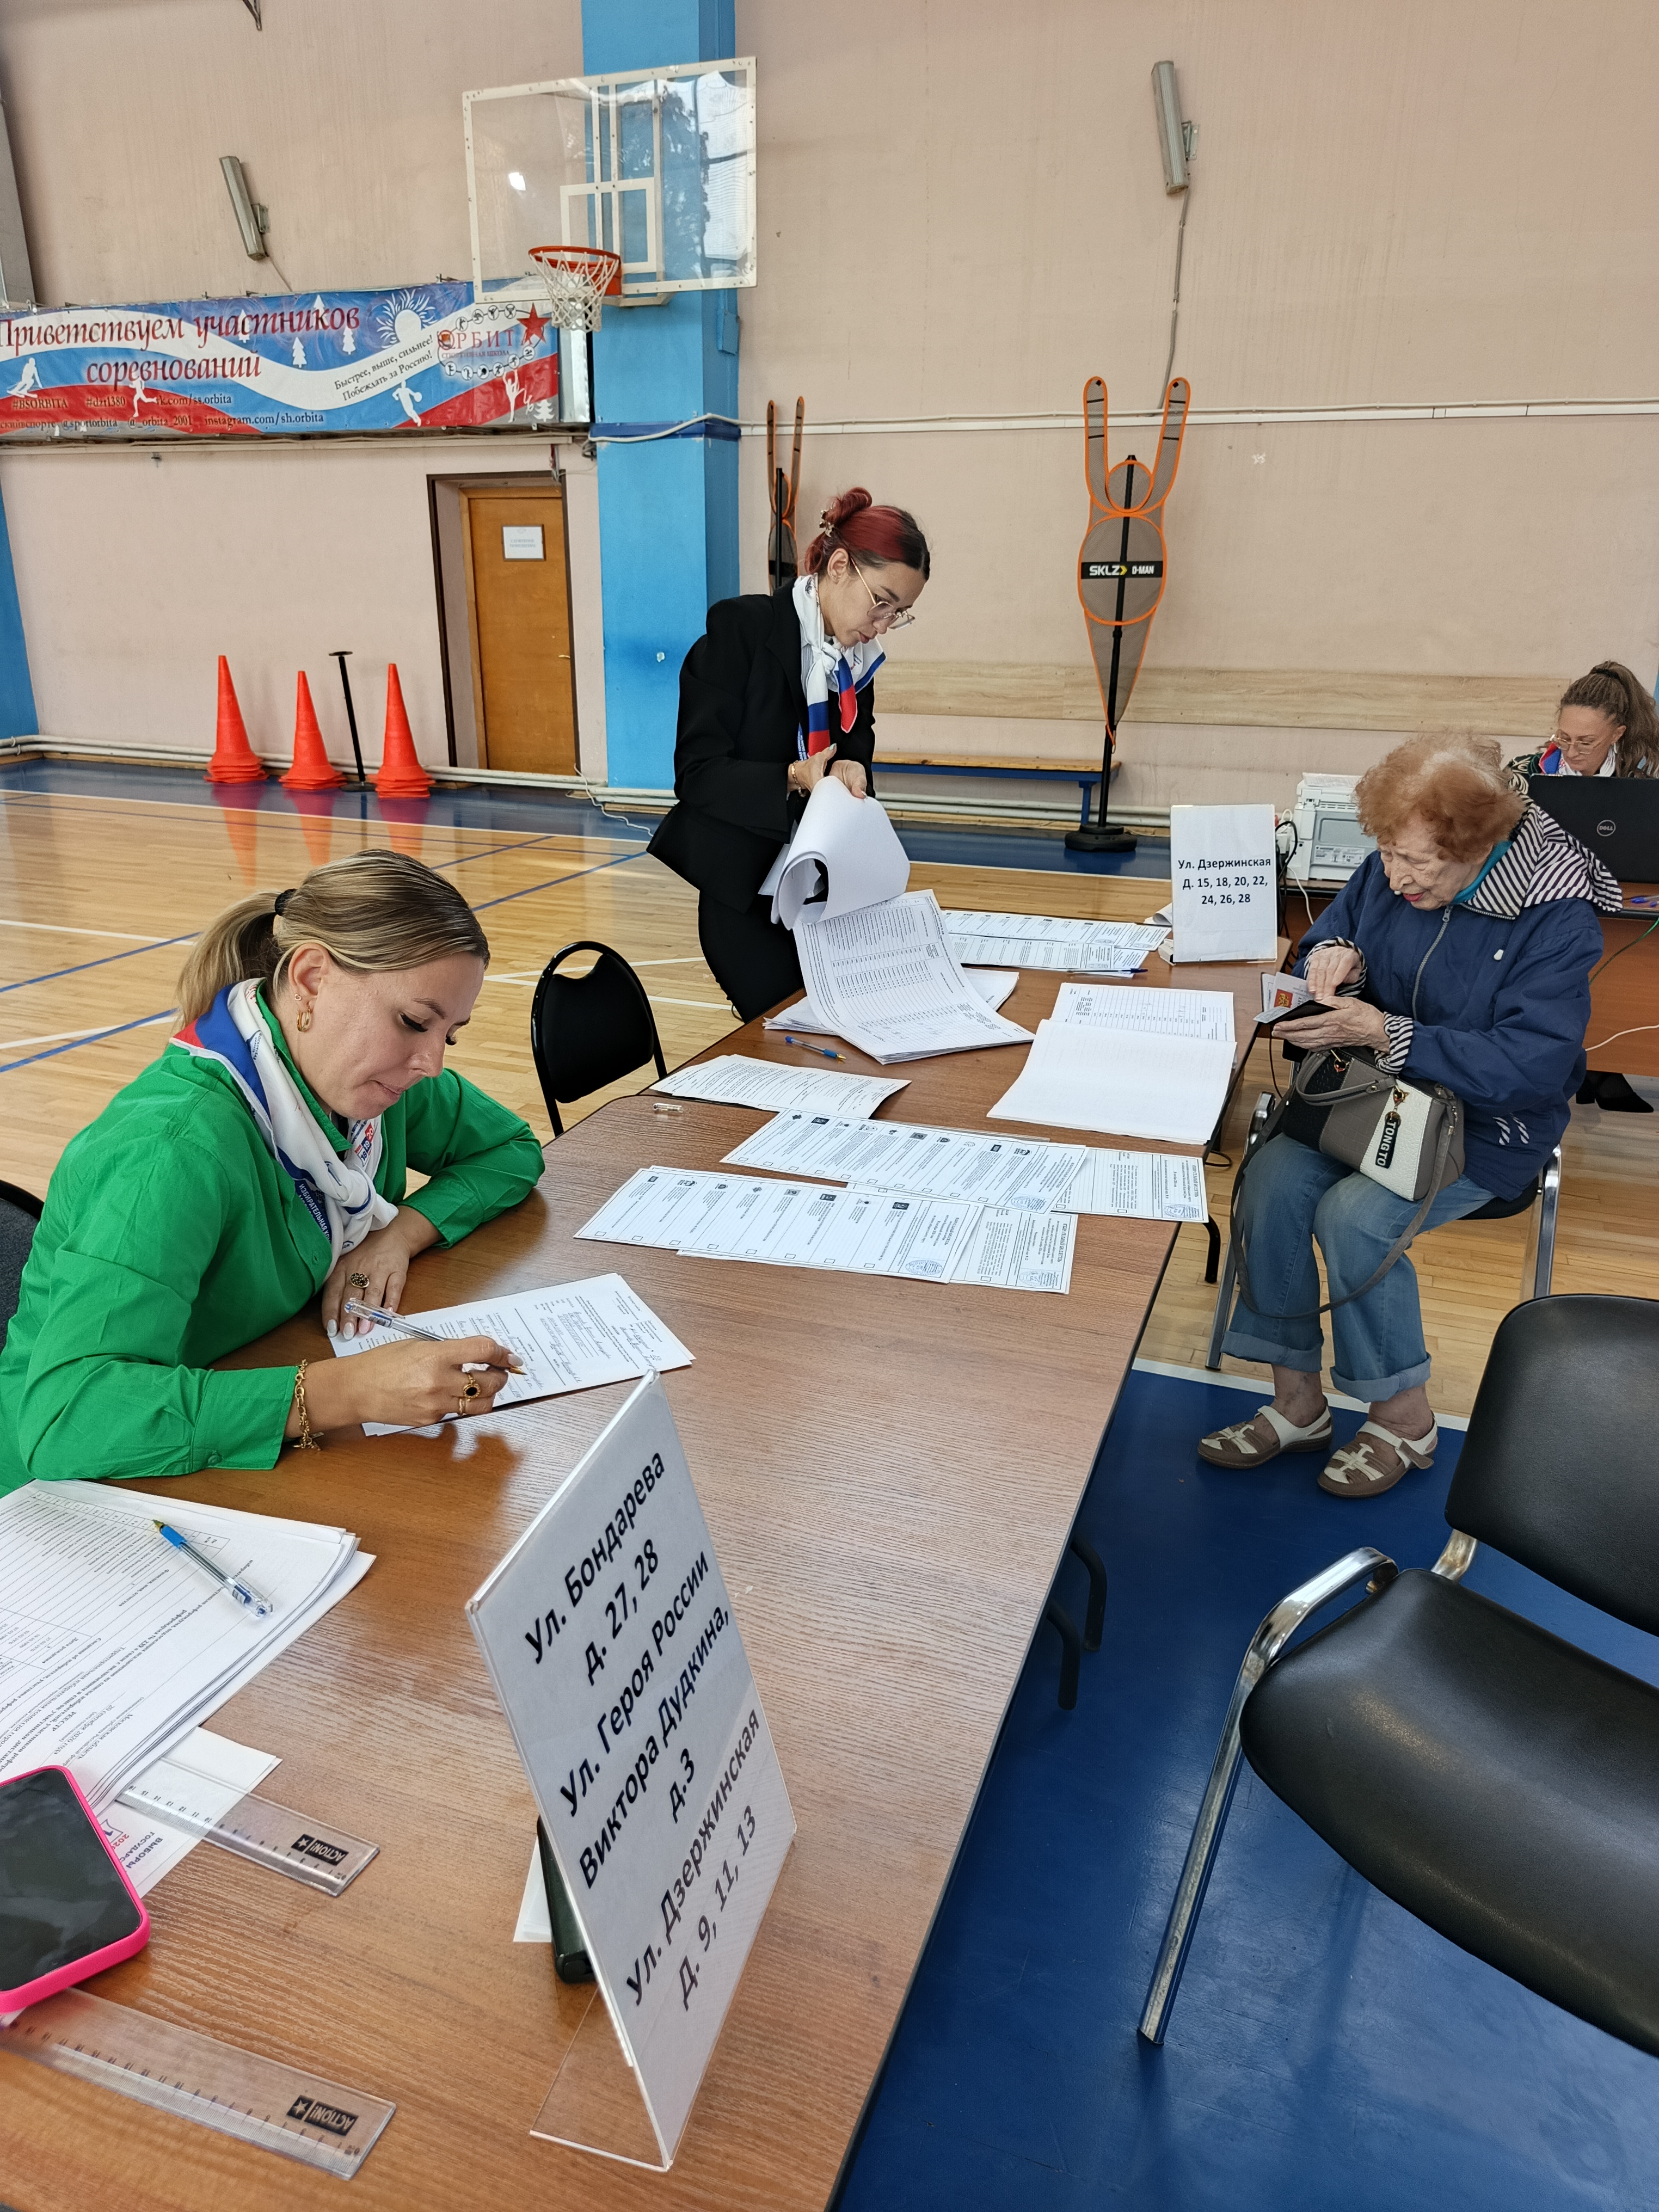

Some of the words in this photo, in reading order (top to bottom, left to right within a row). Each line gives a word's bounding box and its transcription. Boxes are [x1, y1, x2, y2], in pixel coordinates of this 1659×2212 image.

[0, 317, 185, 357] Приветствуем
[193, 306, 360, 348] участников
[87, 349, 262, 391] соревнований
[334, 369, 371, 390] Быстрее,
[372, 356, 397, 372] выше,
[398, 334, 433, 358] сильнее!
[342, 376, 388, 401] Побеждать
[389, 370, 398, 379] за
[398, 350, 432, 374] Россию!
[13, 398, 68, 409] #BSORBITA
[1089, 565, 1121, 576] SKLZ
[1178, 859, 1195, 869] Ул.
[1197, 858, 1271, 870] Дзержинская
[1182, 878, 1194, 890] Д.
[1197, 878, 1213, 889] 15,
[1216, 877, 1231, 888] 18,
[1234, 876, 1250, 887] 20,
[1252, 876, 1268, 887] 22,
[1201, 895, 1216, 906] 24,
[1220, 894, 1235, 905] 26,
[1238, 894, 1251, 903] 28
[364, 1140, 370, 1150] 19
[366, 1128, 374, 1140] 20
[1377, 1121, 1397, 1167] TONGTO
[299, 1183, 328, 1231] ИЗБИРАТЕЛЬНАЯ
[525, 1608, 567, 1664] Ул.
[564, 1453, 665, 1608] Бондарева
[605, 1582, 637, 1639] 27,
[635, 1539, 658, 1590] 28
[153, 1609, 188, 1635] референдума
[65, 1637, 80, 1646] Дата
[77, 1637, 102, 1655] Сведения
[42, 1658, 73, 1680] избирателе,
[79, 1645, 126, 1680] Территориальная
[15, 1678, 45, 1699] участнике
[80, 1664, 118, 1692] включением
[560, 1758, 600, 1817] Ул.
[597, 1650, 654, 1754] Героя
[652, 1551, 709, 1656] России
[40, 1679, 82, 1710] избирательная
[54, 1694, 78, 1711] список
[12, 1709, 44, 1732] комиссия
[48, 1695, 87, 1724] избирателей,
[50, 1711, 77, 1731] РЕЕСТР
[79, 1710, 107, 1730] сентября
[14, 1723, 53, 1752] участников
[18, 1710, 59, 1740] участников
[99, 1713, 134, 1740] Московская
[51, 1742, 69, 1755] года
[75, 1740, 101, 1760] область
[580, 1735, 659, 1889] Виктора
[658, 1607, 729, 1748] Дудкина,
[126, 1836, 163, 1869] ВЫБОРЫ
[310, 1842, 346, 1863] ACTION!
[626, 1944, 662, 2006] Ул.
[661, 1709, 759, 1946] Дзержинская
[698, 1915, 716, 1952] 9,
[715, 1859, 739, 1912] 11,
[737, 1805, 756, 1856] 13
[311, 2105, 355, 2130] ACTION!
